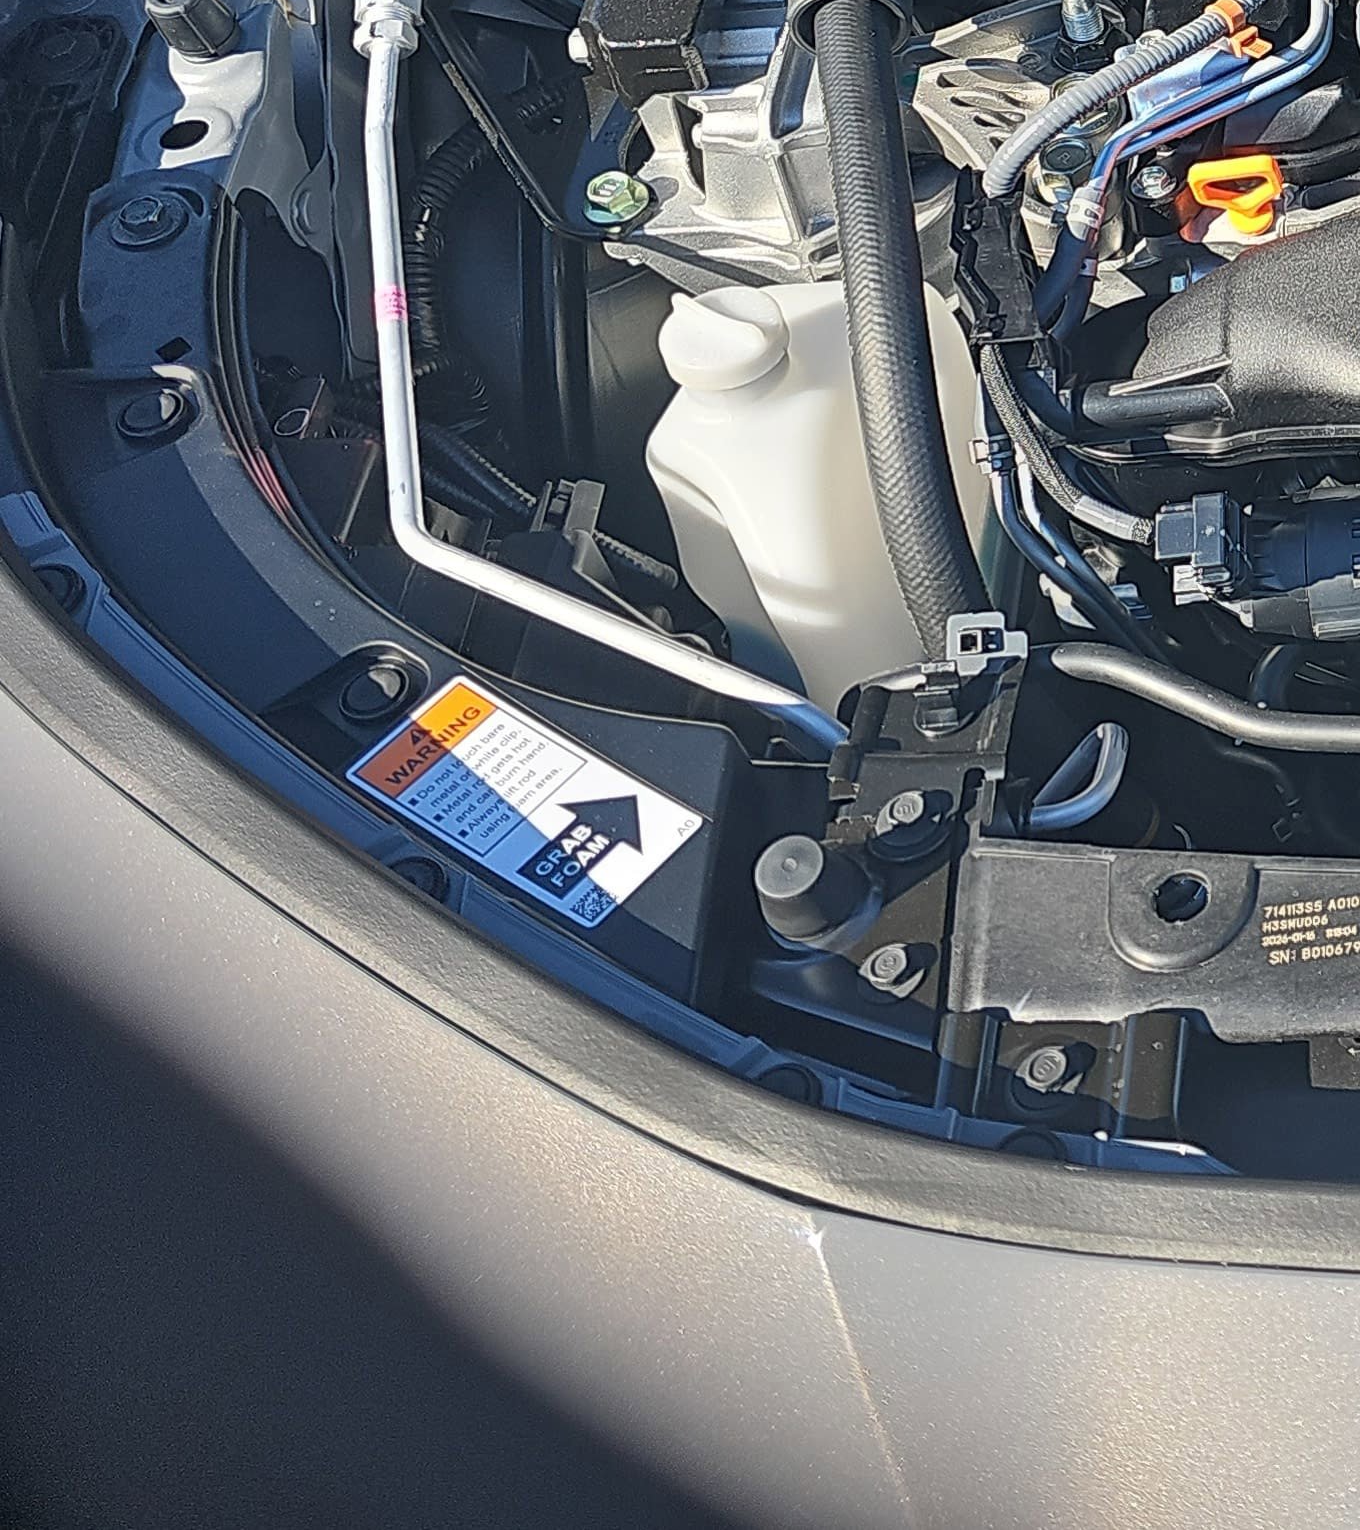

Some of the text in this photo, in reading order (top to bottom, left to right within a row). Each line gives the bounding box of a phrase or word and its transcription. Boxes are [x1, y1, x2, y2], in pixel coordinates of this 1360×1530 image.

[385, 706, 482, 786] WARNING
[417, 724, 505, 800] Do not touch bare
[442, 737, 532, 816] Metal rod gets hot
[430, 781, 460, 808] metal
[461, 770, 473, 782] or
[472, 747, 500, 772] white
[455, 805, 477, 824] and
[477, 788, 497, 806] can
[495, 765, 521, 787] burn
[468, 769, 537, 833] Always lift rod
[479, 811, 512, 839] using
[535, 824, 593, 876] GRAB
[550, 833, 611, 888] FOAM
